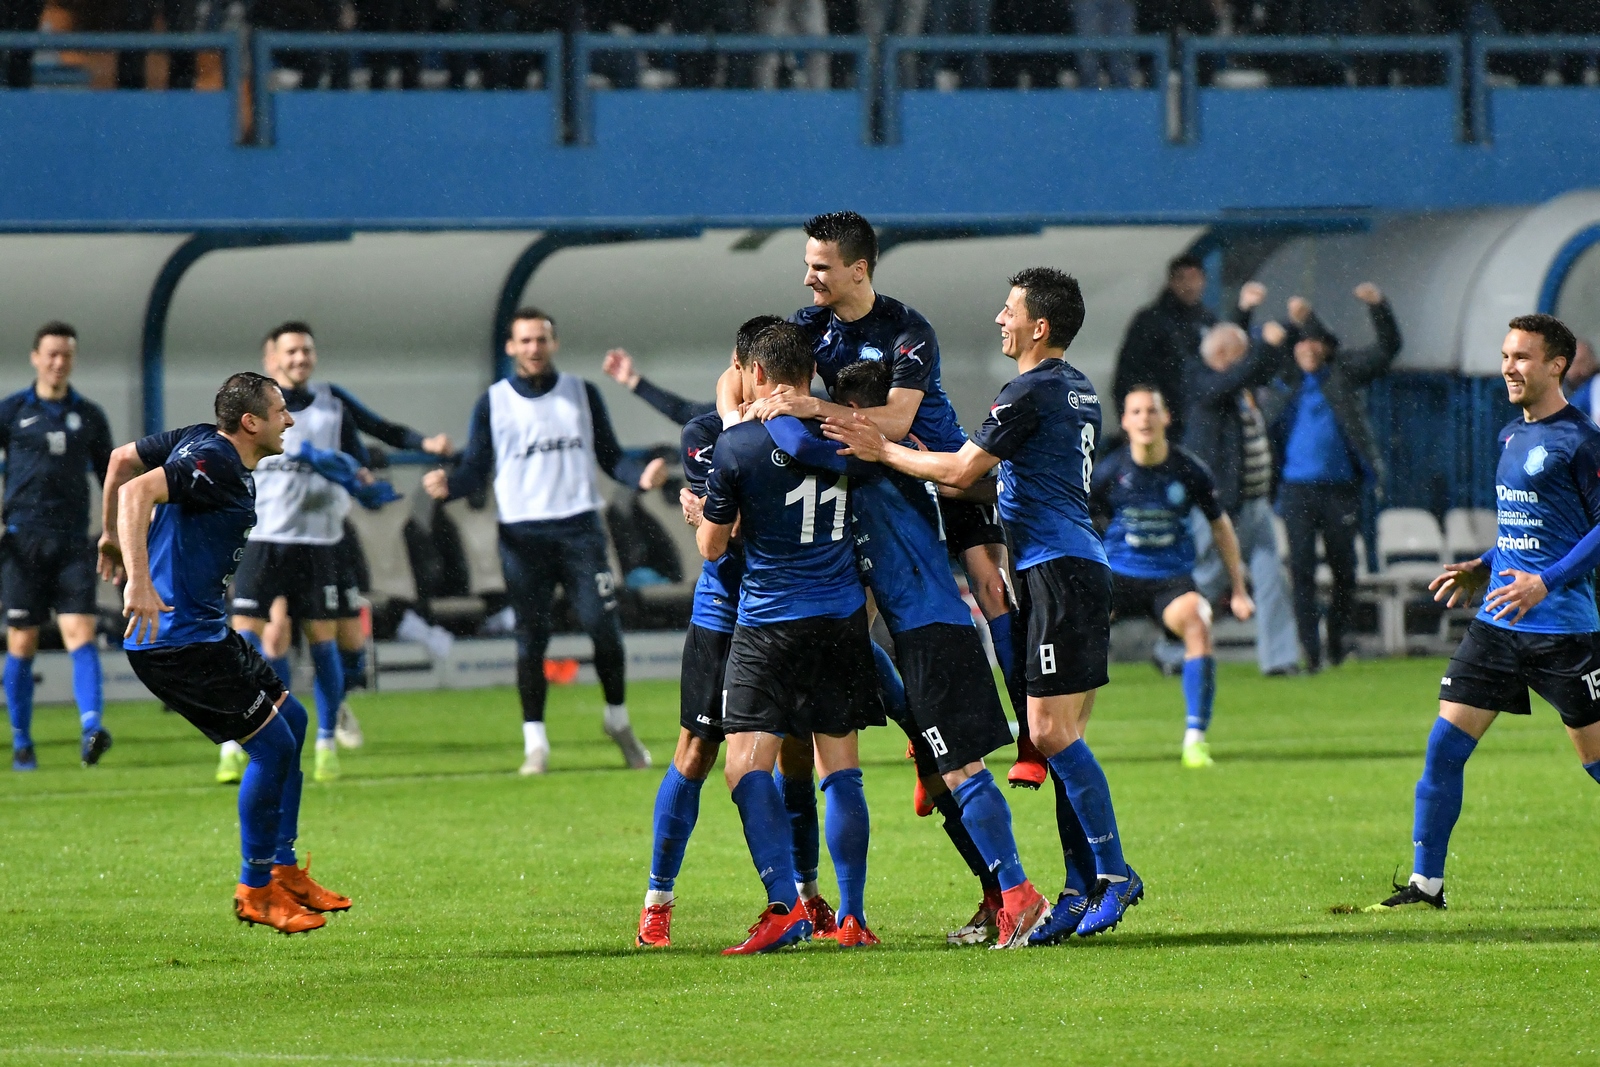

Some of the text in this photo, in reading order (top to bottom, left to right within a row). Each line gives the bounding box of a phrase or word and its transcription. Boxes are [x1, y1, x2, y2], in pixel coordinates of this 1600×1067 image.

[1080, 422, 1095, 493] 8
[784, 475, 849, 544] 11
[1039, 643, 1057, 675] 8
[921, 725, 949, 758] 18
